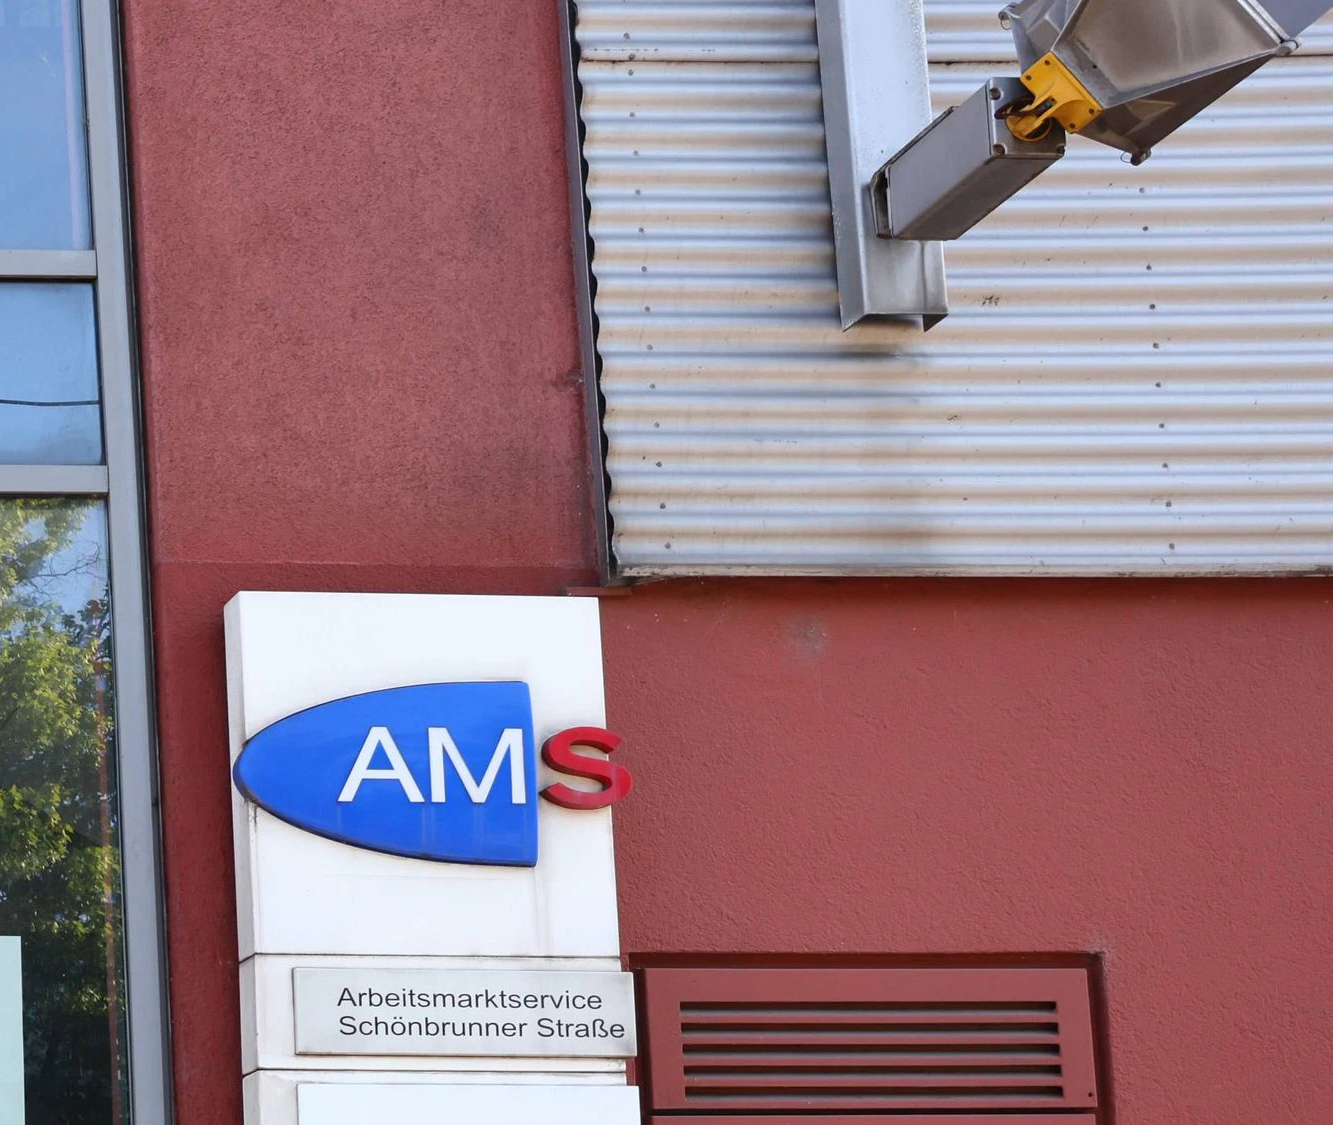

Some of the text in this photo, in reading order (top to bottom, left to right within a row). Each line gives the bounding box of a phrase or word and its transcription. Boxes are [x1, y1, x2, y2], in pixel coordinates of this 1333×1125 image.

[337, 726, 632, 810] AMS
[336, 987, 602, 1009] Arbeitsmarktservice
[339, 1015, 625, 1038] Schönbrunner Straße
